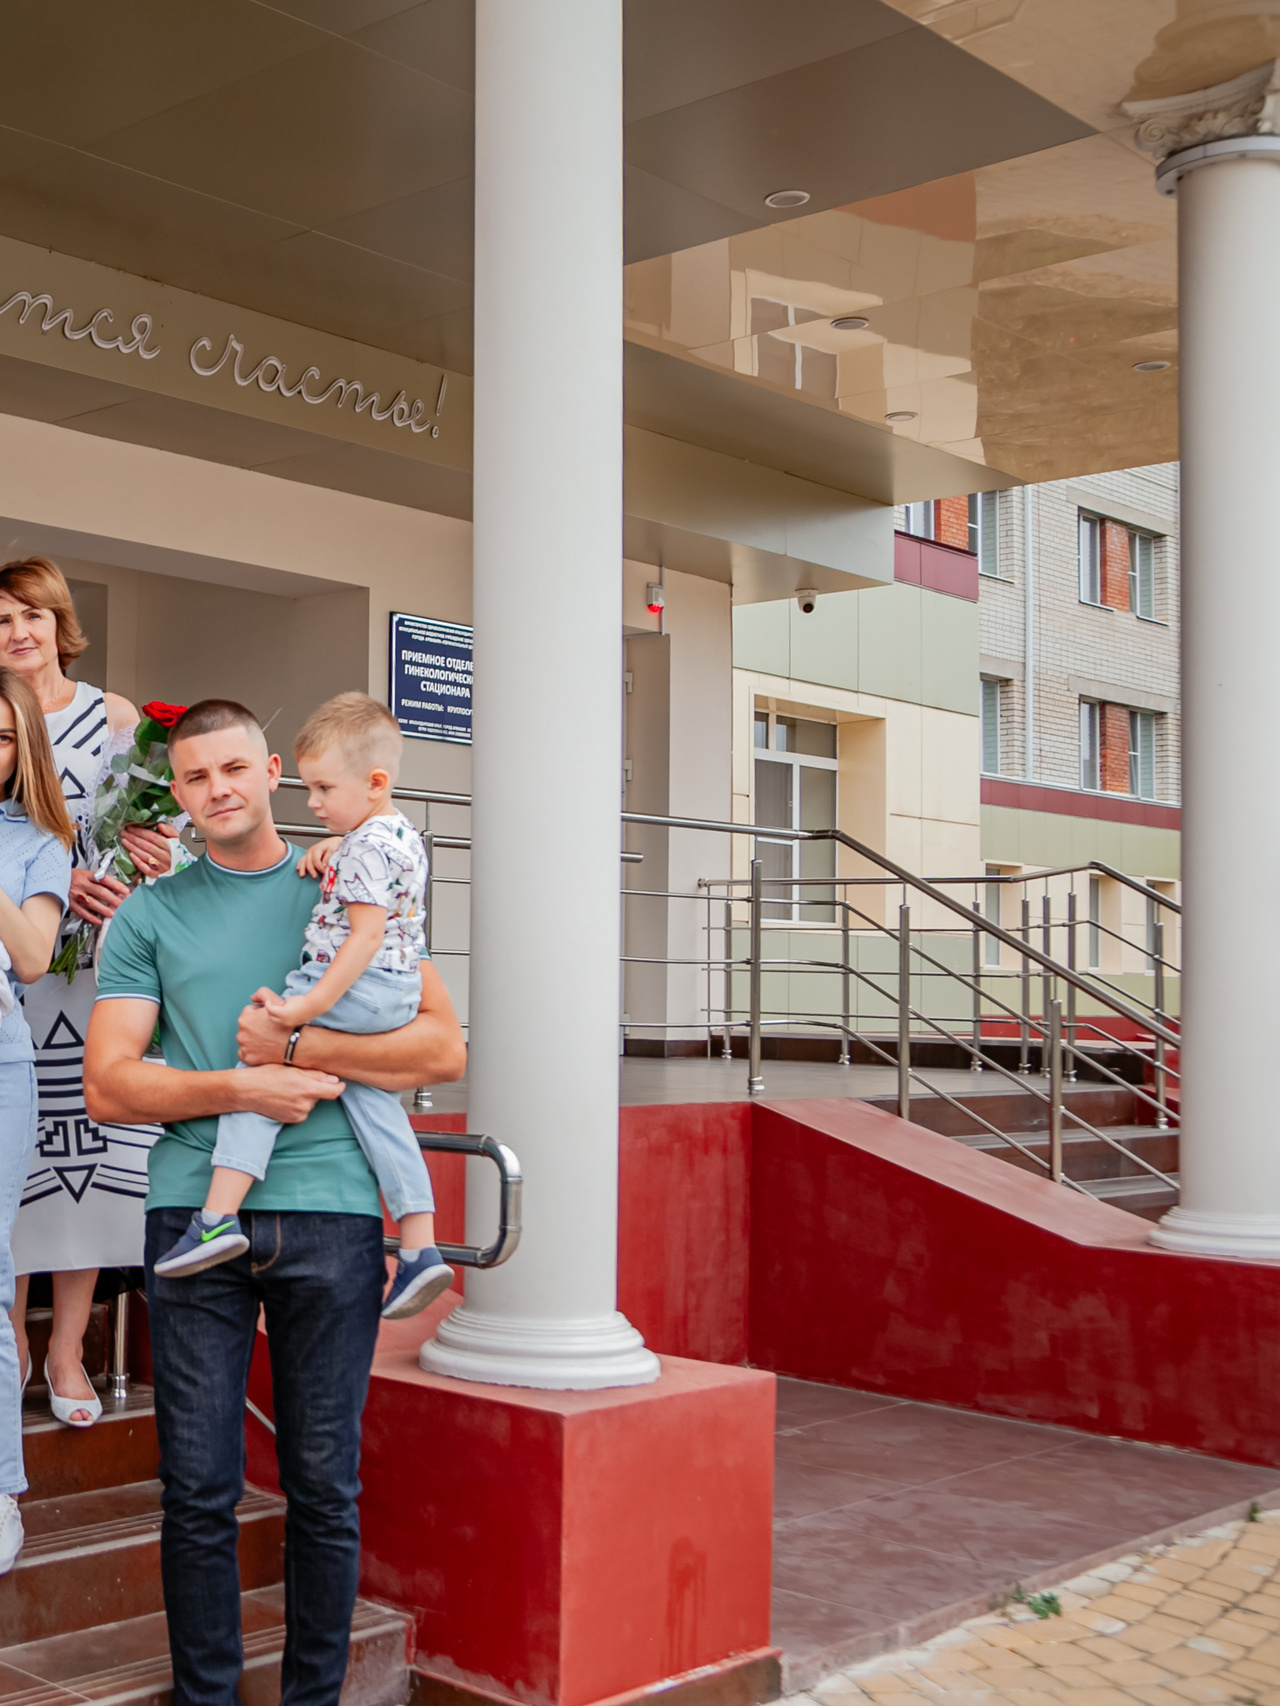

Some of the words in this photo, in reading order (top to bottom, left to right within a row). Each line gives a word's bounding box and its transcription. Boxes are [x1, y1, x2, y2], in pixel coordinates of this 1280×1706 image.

[189, 334, 447, 439] счастье!
[401, 649, 446, 667] ПРИЕМНОЕ
[404, 664, 474, 685] ГИНЕКОЛОГИЧЕСК
[420, 680, 471, 698] СТАЦИОНАРА
